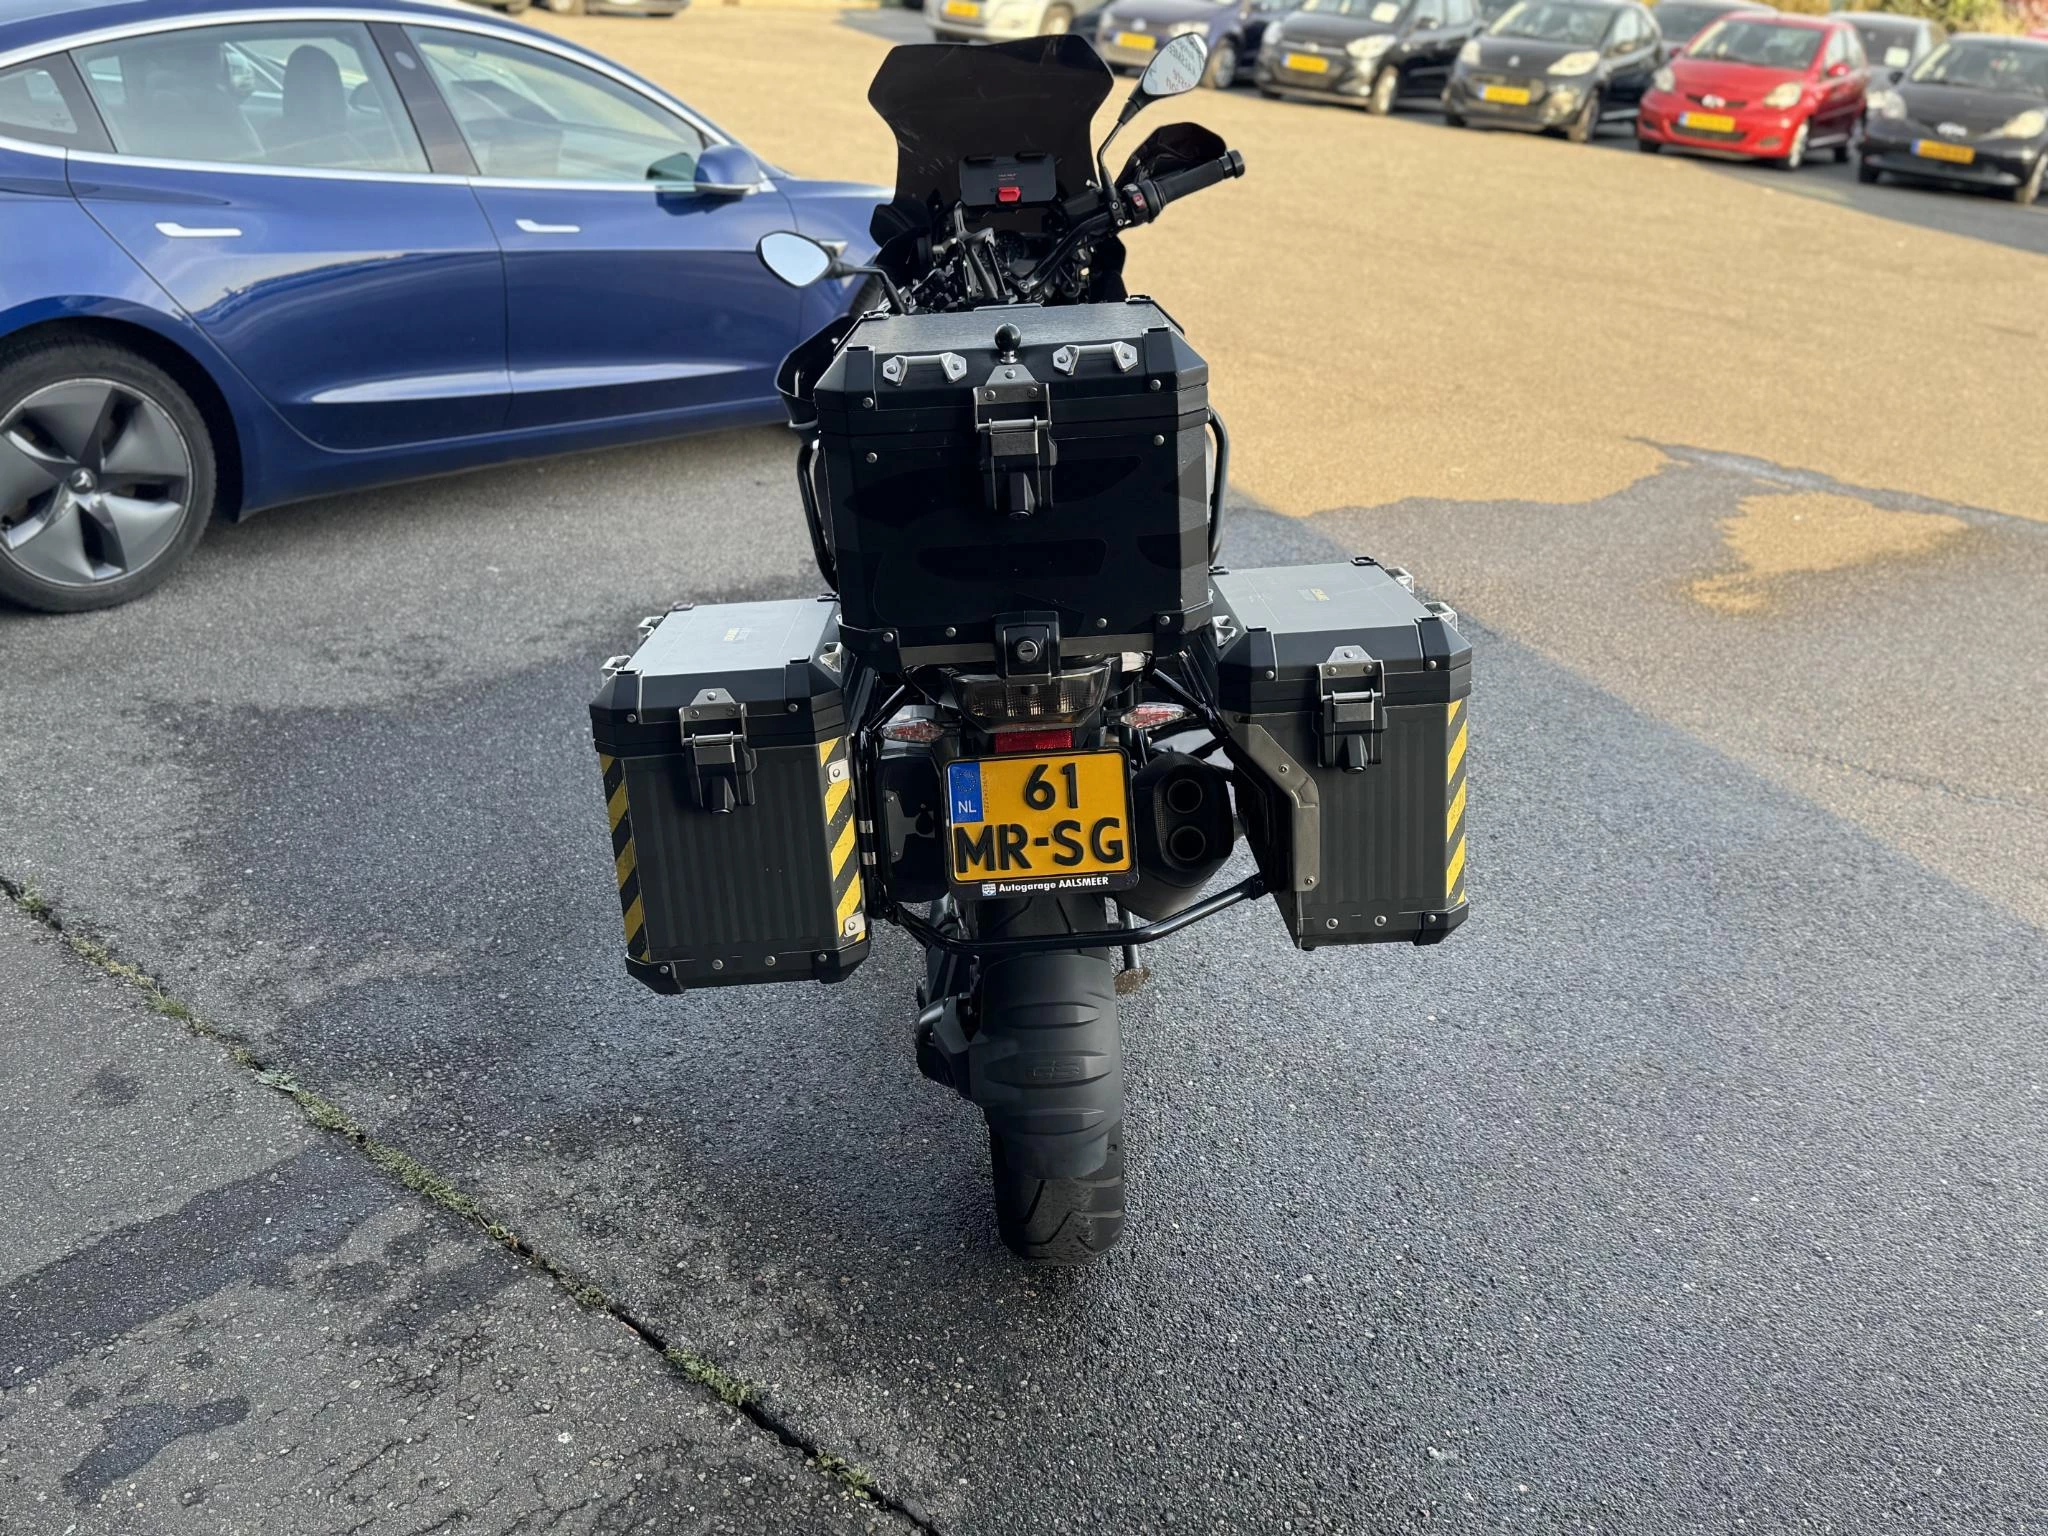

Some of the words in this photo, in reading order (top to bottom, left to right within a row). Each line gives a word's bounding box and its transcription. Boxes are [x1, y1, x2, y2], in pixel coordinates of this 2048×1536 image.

[1024, 763, 1079, 811] 61
[958, 800, 977, 814] NL
[955, 817, 1125, 873] MR-SG
[999, 882, 1057, 893] Autogarage
[1058, 876, 1109, 888] AALSMEER
